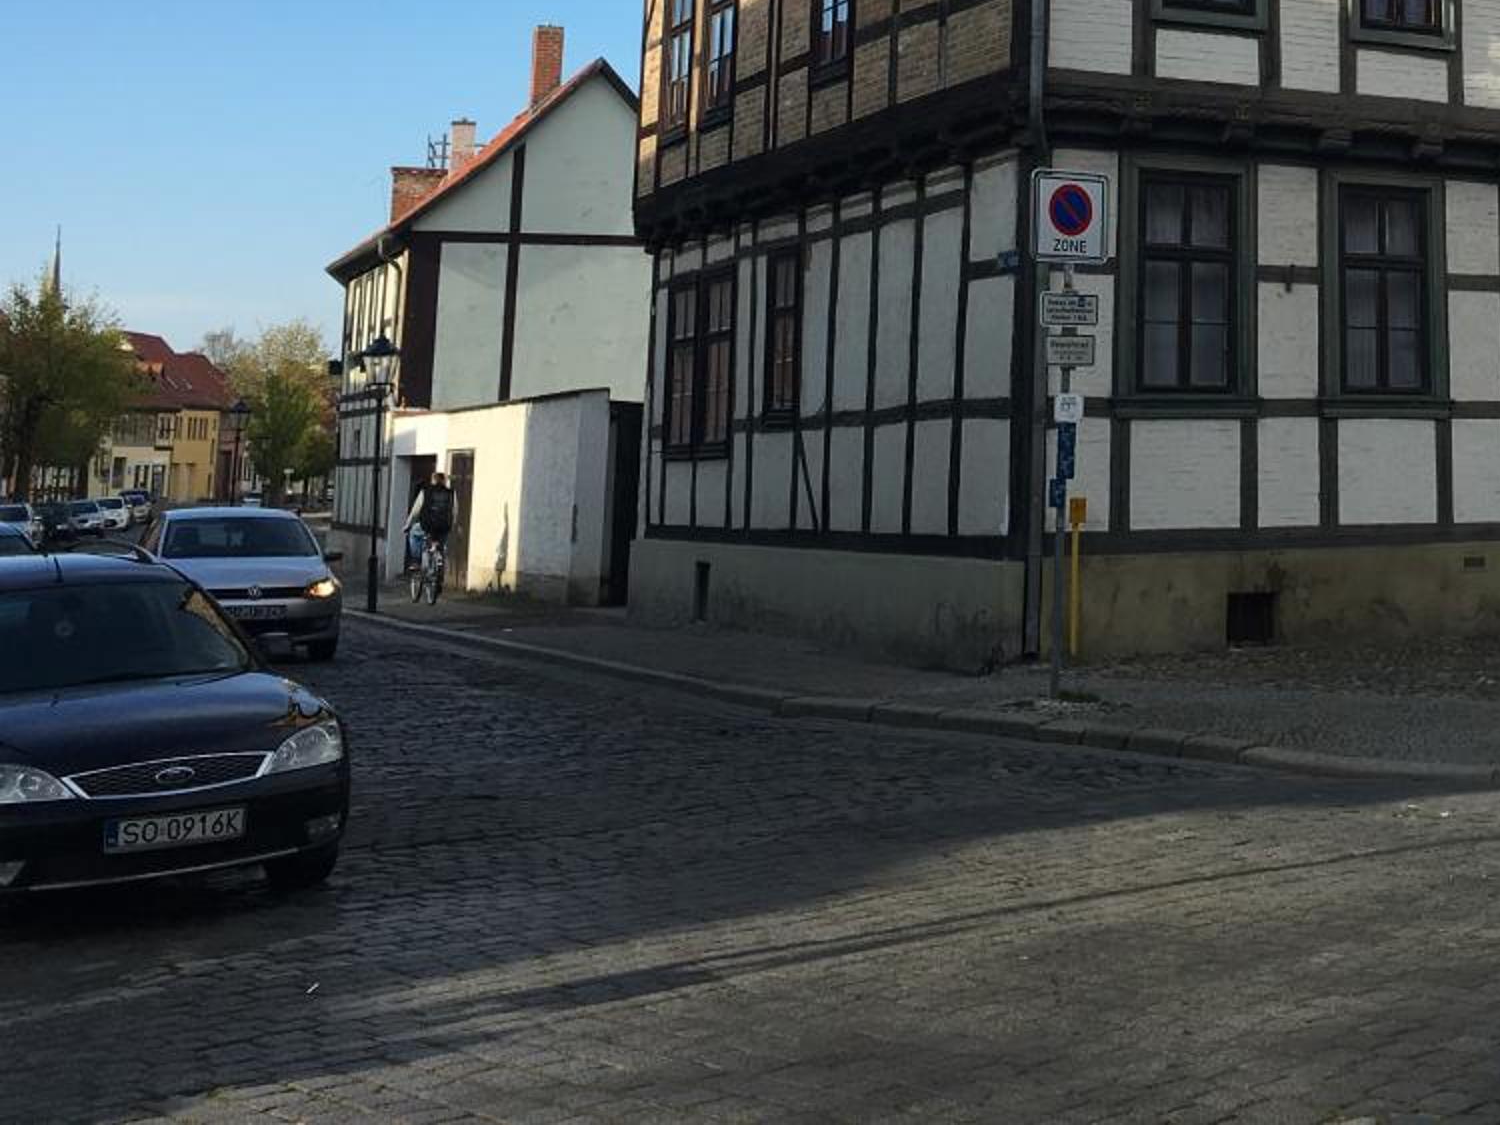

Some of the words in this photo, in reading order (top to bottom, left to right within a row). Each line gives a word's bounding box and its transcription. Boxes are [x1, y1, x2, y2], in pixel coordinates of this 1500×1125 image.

[1053, 239, 1087, 254] ZONE
[123, 821, 159, 844] SO
[166, 811, 240, 841] 0916K
